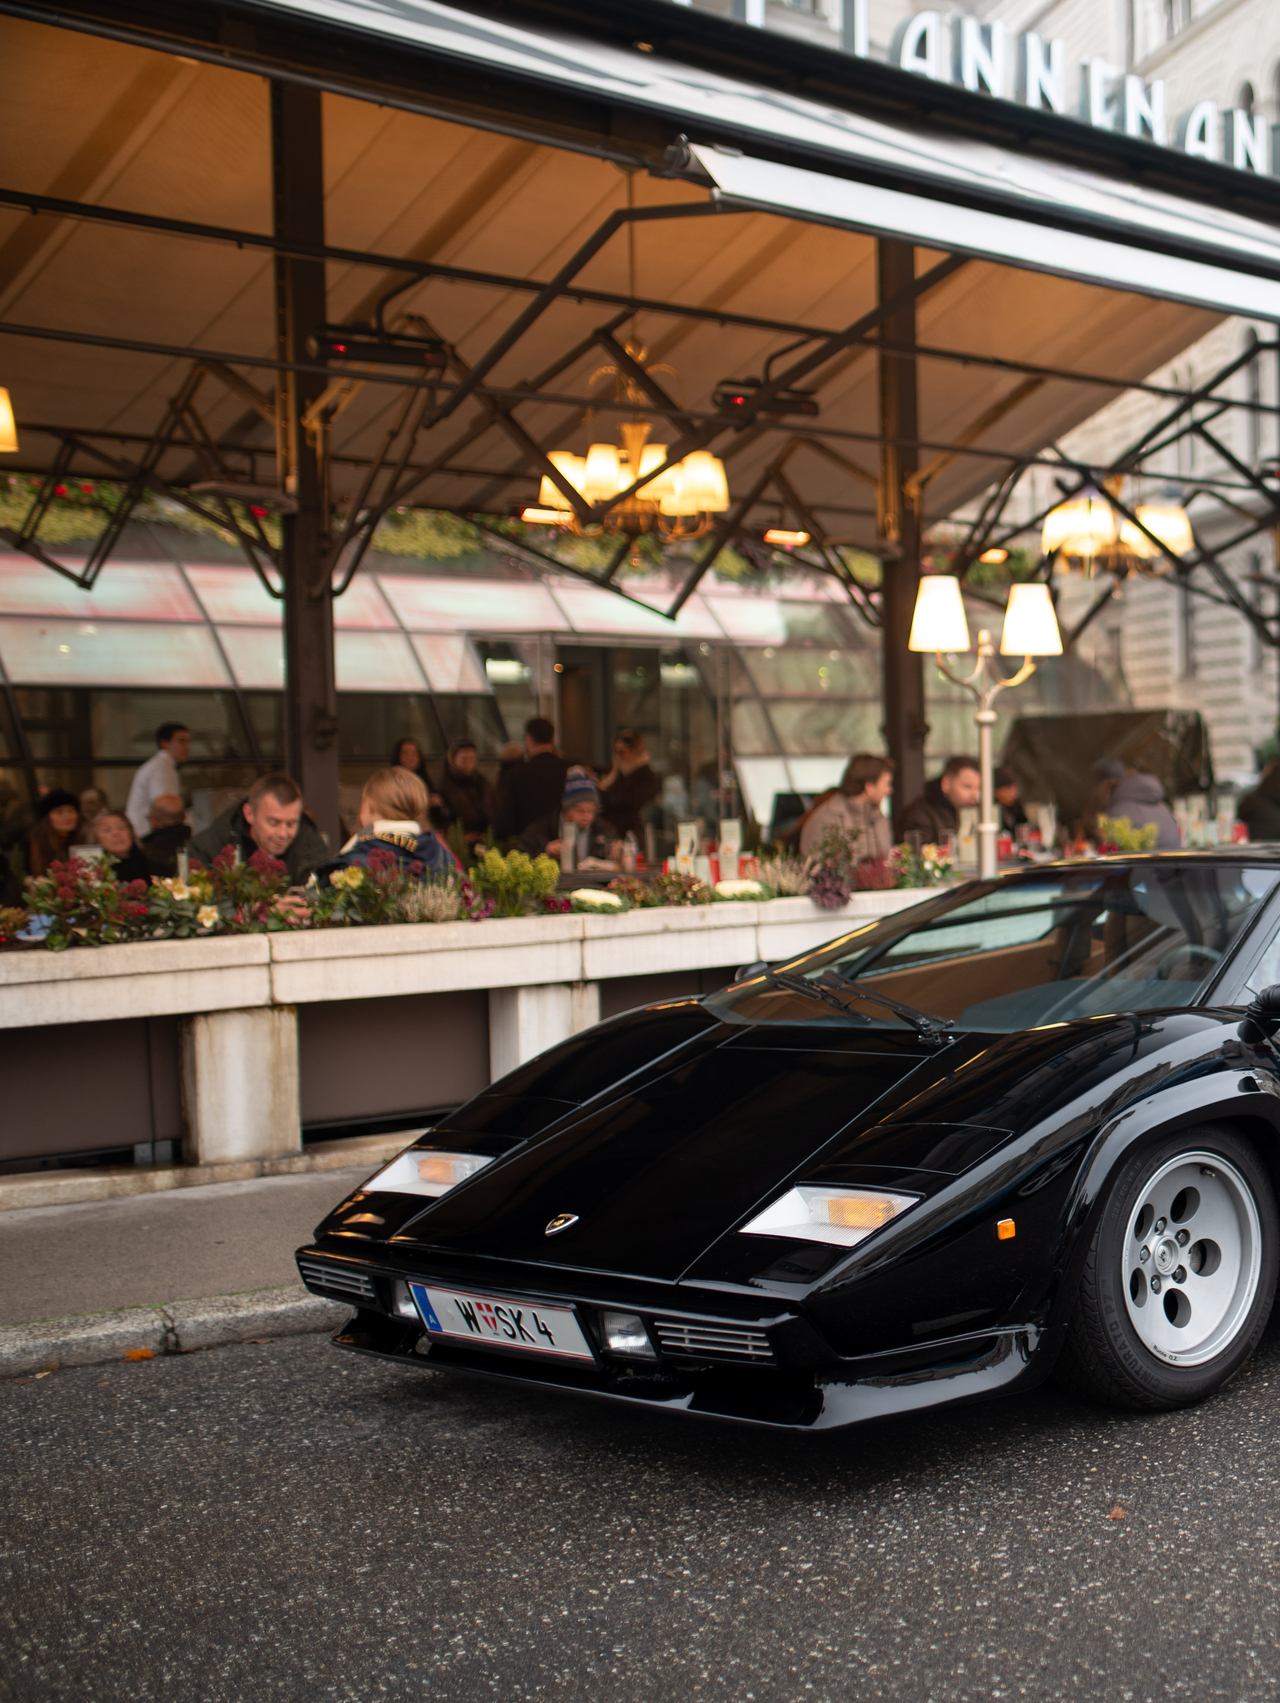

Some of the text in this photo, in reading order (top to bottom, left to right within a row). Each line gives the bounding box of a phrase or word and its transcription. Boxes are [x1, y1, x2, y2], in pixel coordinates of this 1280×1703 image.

[428, 1314, 437, 1325] A
[454, 1297, 482, 1334] W
[1102, 1294, 1161, 1389] CINTURATO P7
